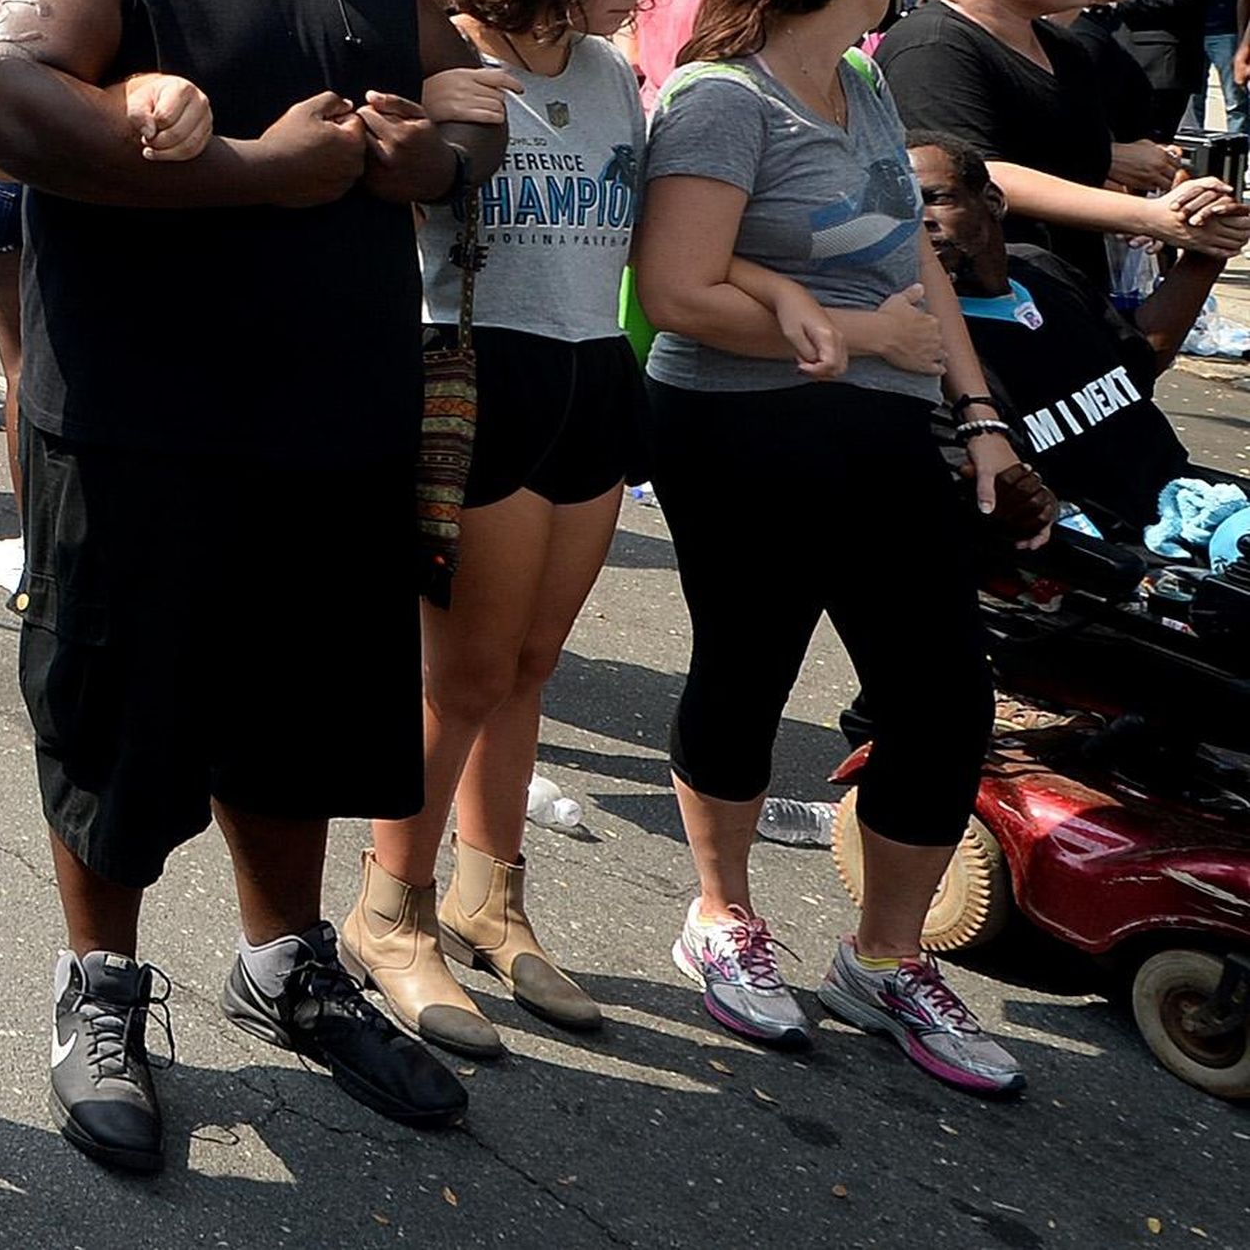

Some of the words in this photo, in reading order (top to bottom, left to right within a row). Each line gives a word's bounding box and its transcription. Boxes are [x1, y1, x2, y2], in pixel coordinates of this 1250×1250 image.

[501, 152, 585, 172] FERENCE
[478, 175, 632, 228] HAMPIO
[455, 232, 566, 245] CROLINA
[1055, 399, 1084, 436] I
[1071, 365, 1143, 427] NEXT
